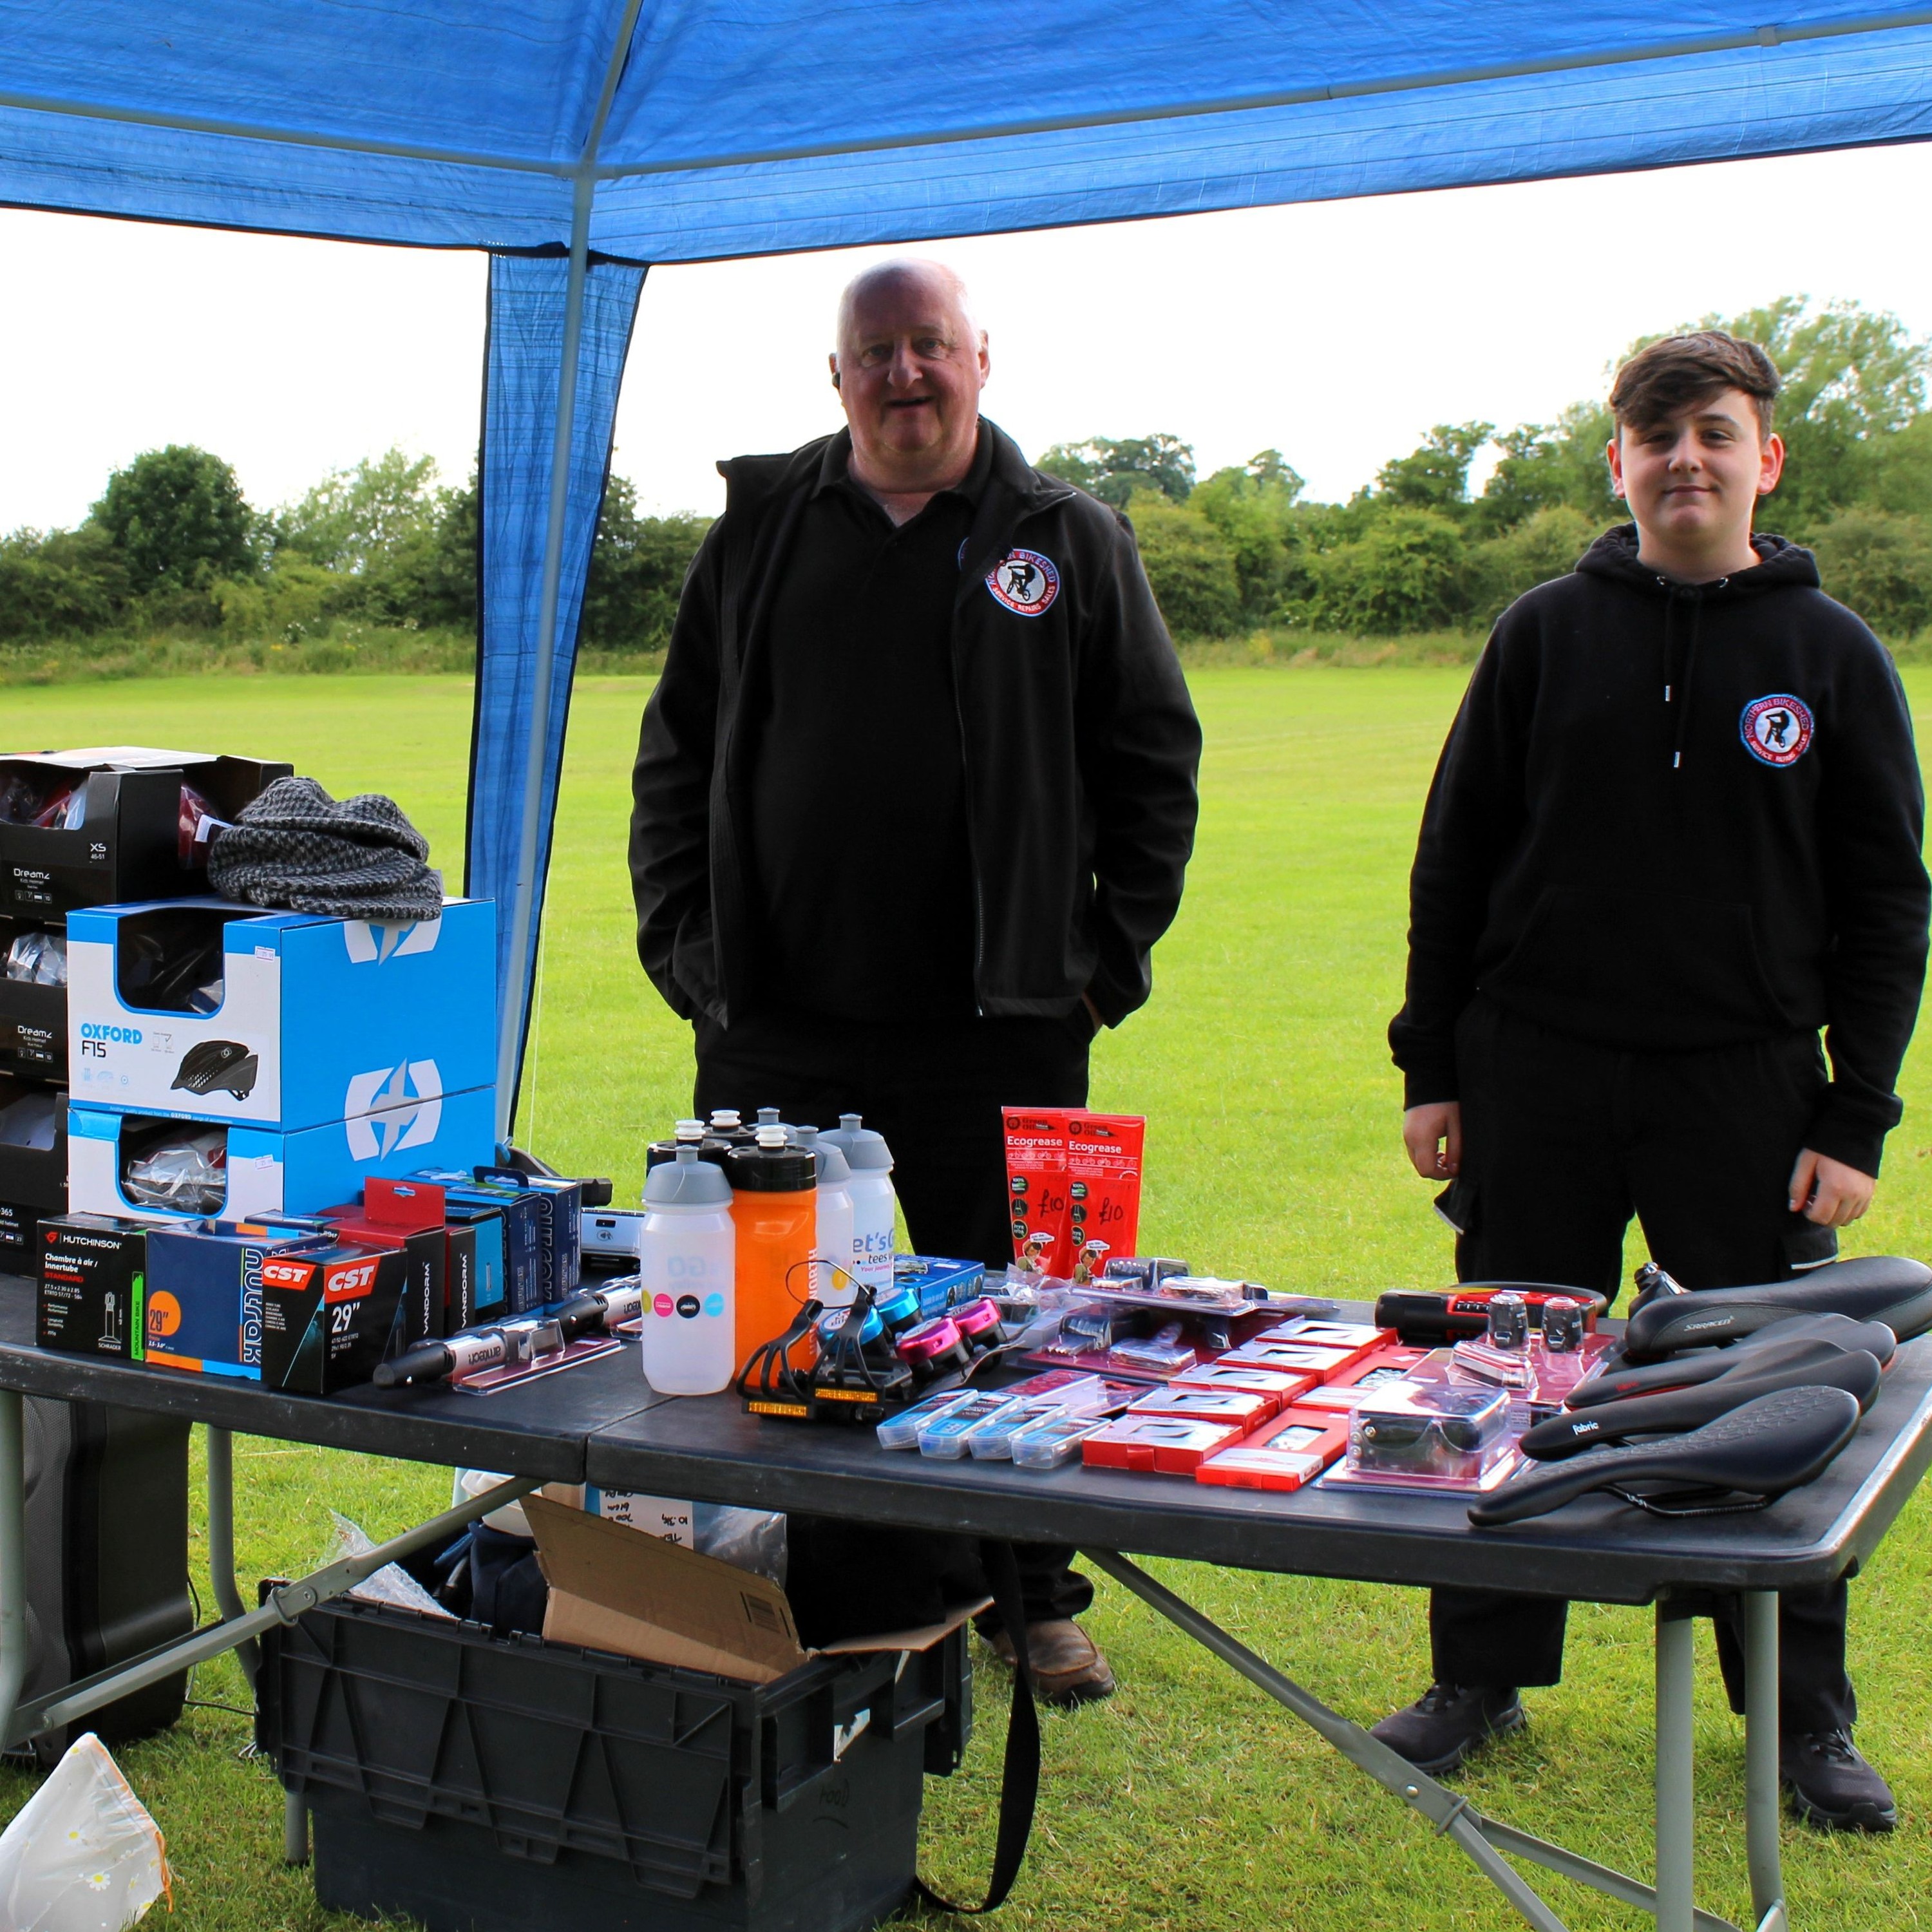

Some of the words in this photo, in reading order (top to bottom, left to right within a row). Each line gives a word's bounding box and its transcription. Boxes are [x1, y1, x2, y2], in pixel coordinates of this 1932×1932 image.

[1019, 552, 1056, 582] BIKESHED
[992, 587, 1015, 608] SERVICE
[1042, 585, 1056, 604] SALES
[1018, 603, 1041, 612] REPAIRS
[1745, 700, 1772, 739] NORTHERN
[1774, 698, 1809, 730] BIKESHED
[1750, 741, 1773, 760] SERVICE
[90, 843, 106, 852] XS
[14, 868, 50, 880] Dreamz
[17, 1025, 52, 1039] Dreamz
[80, 1023, 142, 1045] OXFORD
[82, 1040, 106, 1057] F15
[1007, 1135, 1063, 1148] Ecogrease
[1069, 1141, 1122, 1154] Ecogrease
[1037, 1189, 1064, 1218] £10
[1099, 1197, 1124, 1225] £10
[63, 1235, 120, 1250] HUTCHINSON
[853, 1228, 893, 1253] et's
[44, 1261, 79, 1273] Innertube
[45, 1253, 76, 1265] Chambre
[77, 1256, 82, 1265] à
[83, 1258, 93, 1267] air
[868, 1254, 887, 1264] tees
[44, 1272, 84, 1283] STANDARD
[263, 1265, 308, 1283] CST
[328, 1265, 375, 1292] CST
[624, 1300, 641, 1314] tech
[468, 1346, 501, 1365] amtech
[1573, 1421, 1598, 1435] fabric
